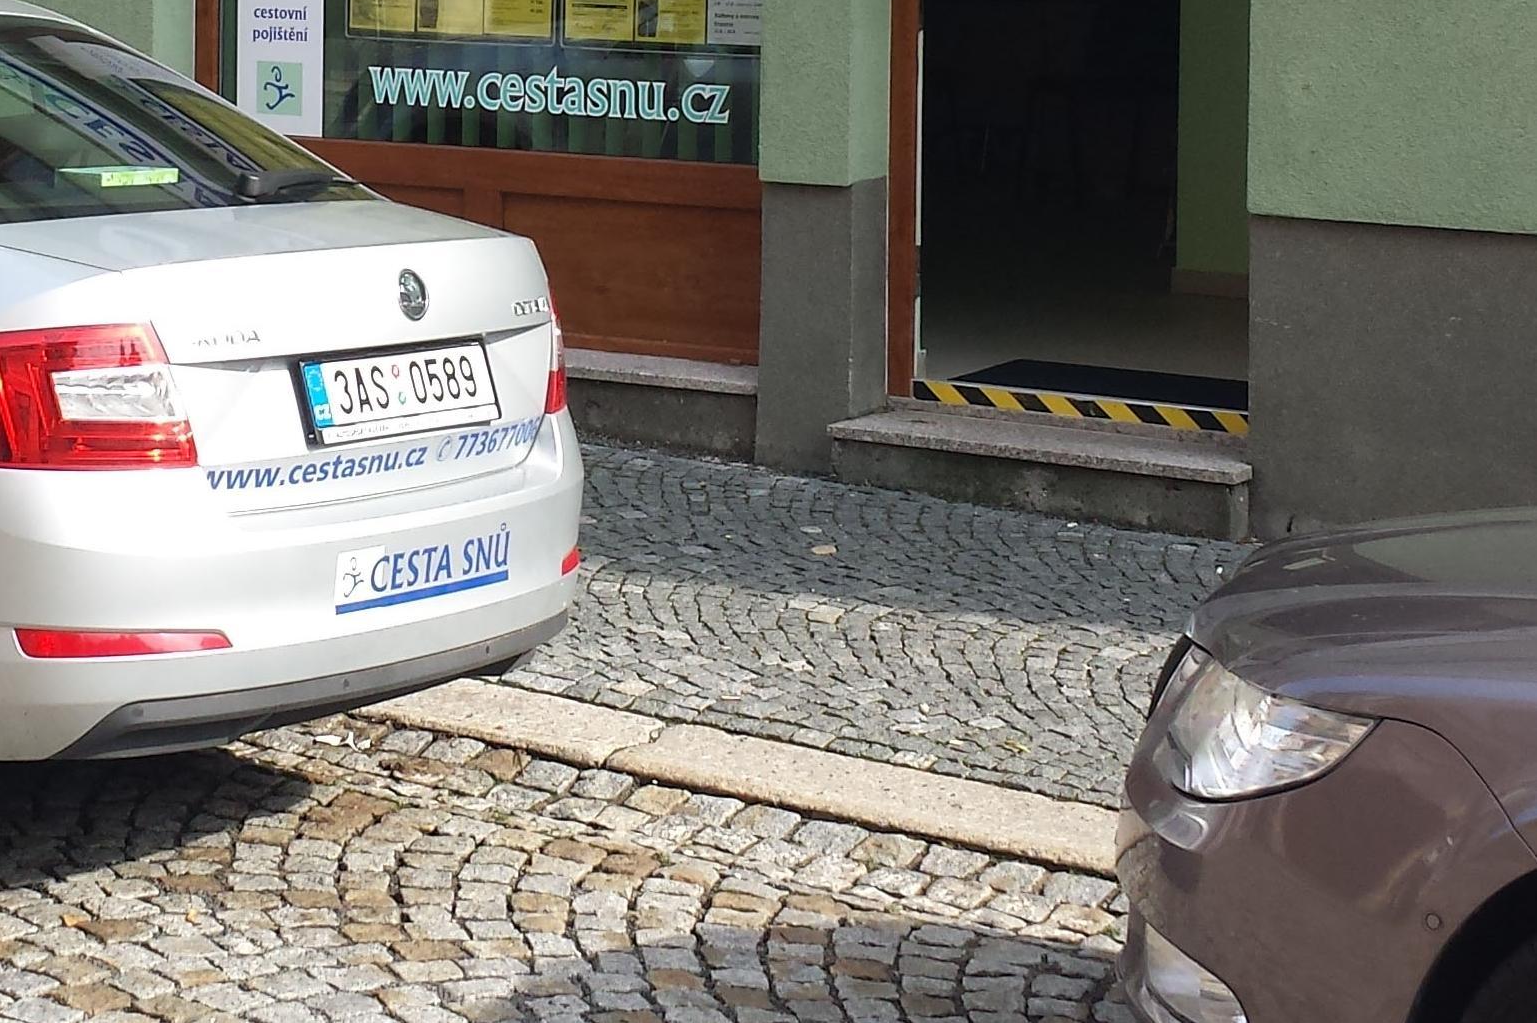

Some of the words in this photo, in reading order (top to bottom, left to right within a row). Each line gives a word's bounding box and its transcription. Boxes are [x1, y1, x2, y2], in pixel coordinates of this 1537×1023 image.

[252, 26, 308, 43] pojištění
[253, 6, 307, 21] cestovní
[367, 62, 731, 125] www.cestasnu.cz
[334, 364, 390, 415] 3AS
[409, 355, 478, 404] 0589
[206, 444, 427, 491] www.cestasnu.cz
[371, 543, 453, 593] CESTA
[462, 522, 511, 575] SNŮ
